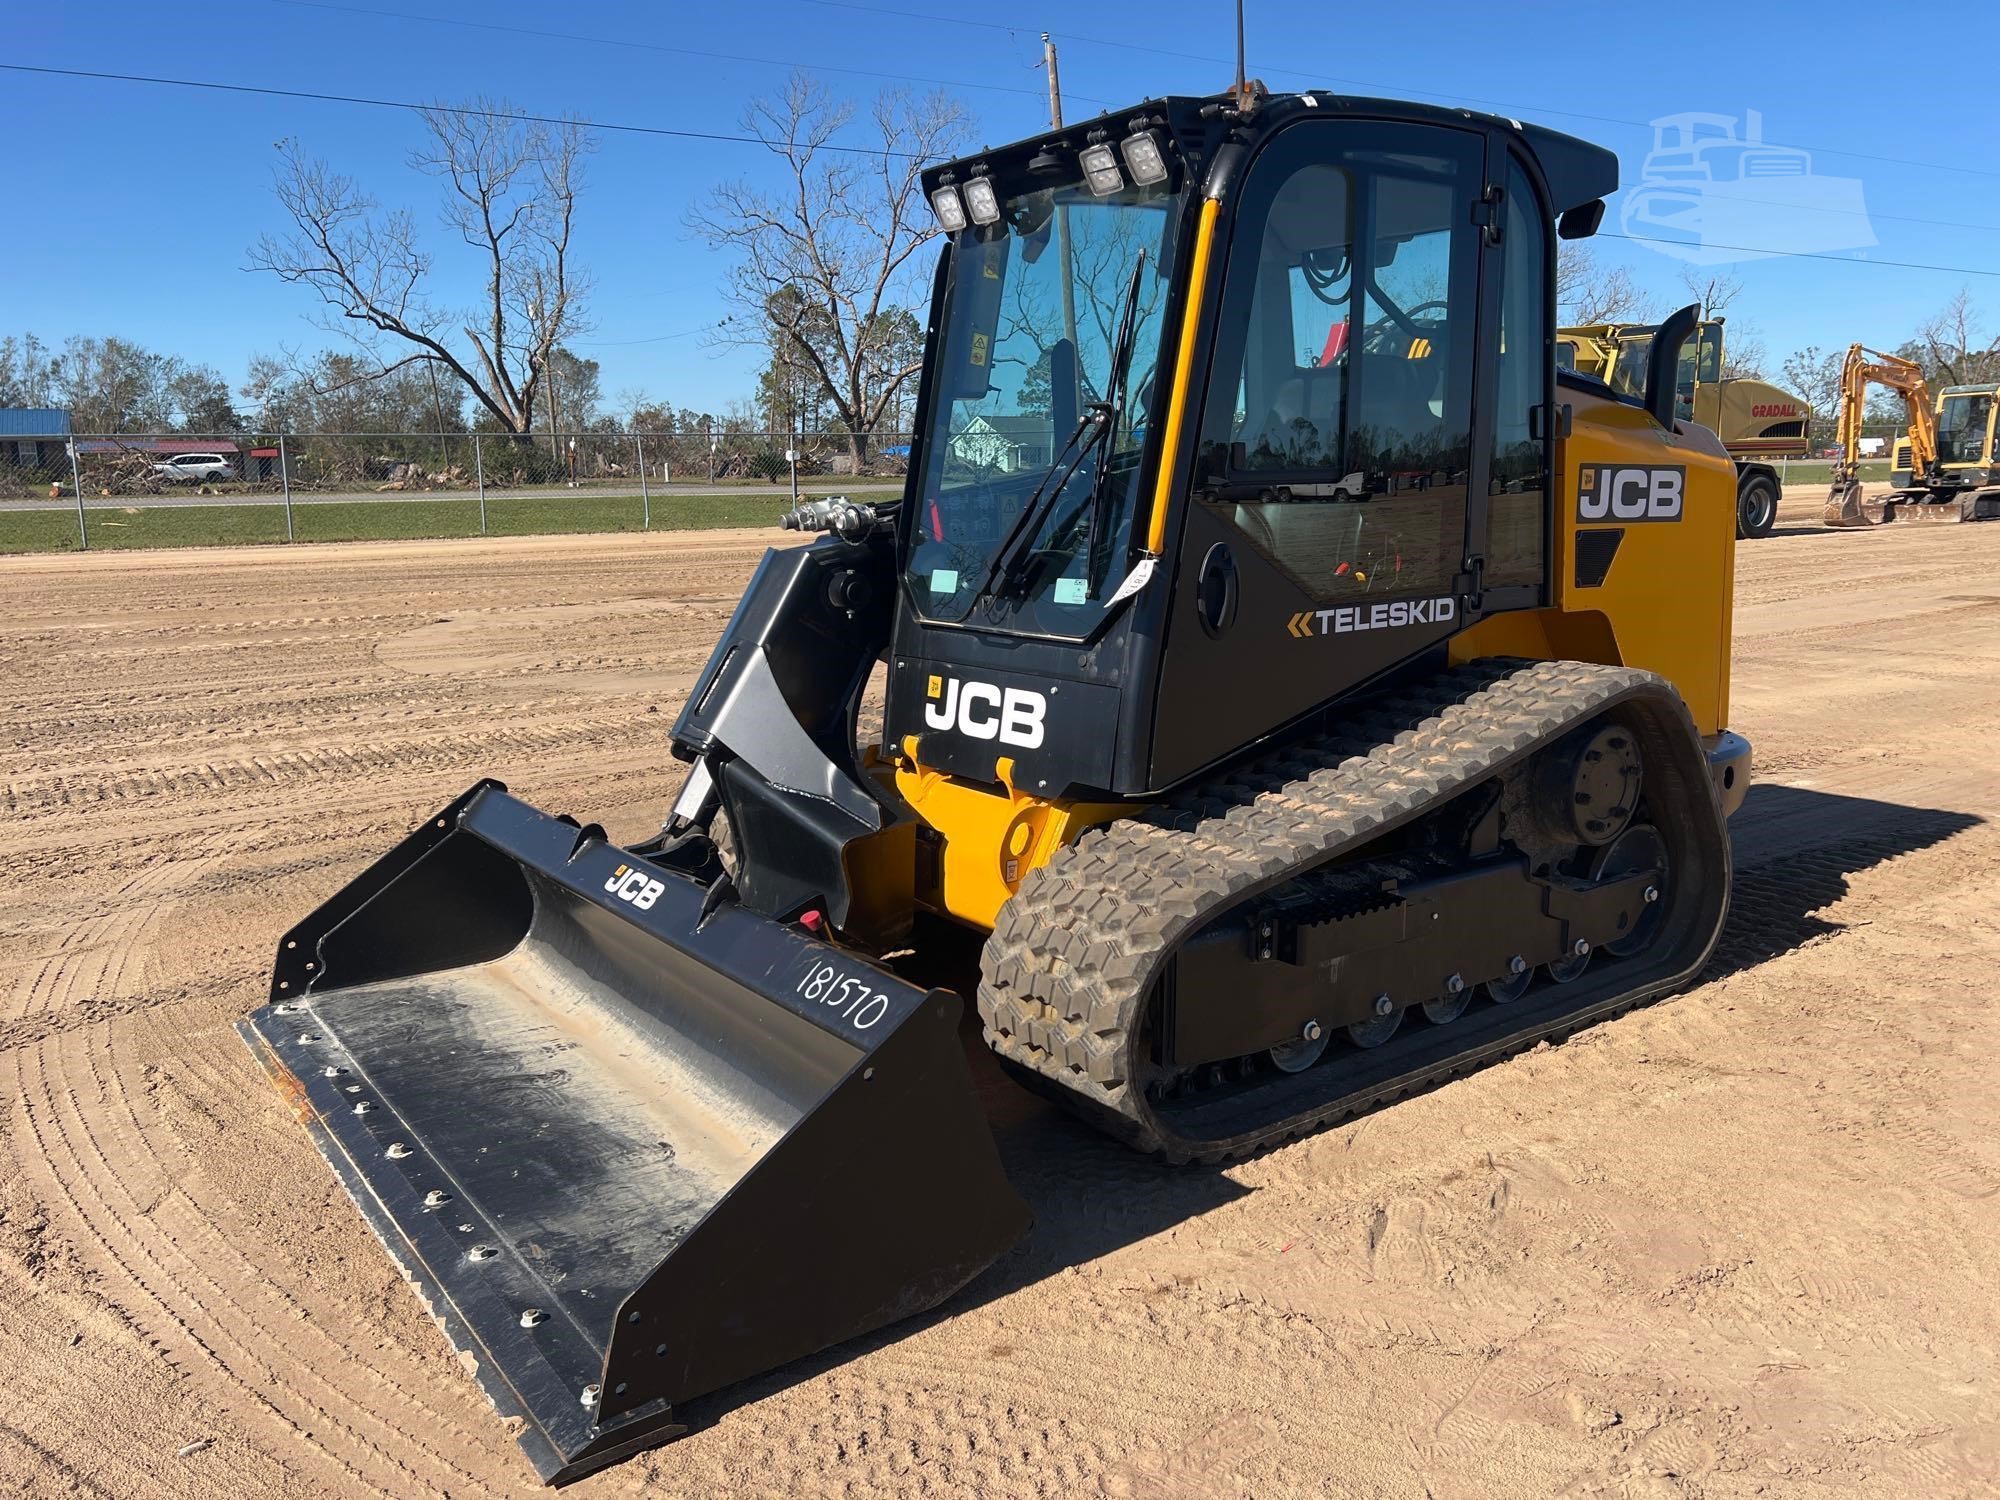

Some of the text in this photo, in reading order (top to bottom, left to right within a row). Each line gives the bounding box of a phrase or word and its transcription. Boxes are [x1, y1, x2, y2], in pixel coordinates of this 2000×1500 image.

[1752, 404, 1797, 418] GRADALL
[1580, 469, 1682, 518] JCB
[1315, 597, 1455, 635] TELESKID
[925, 677, 1047, 750] JCB
[604, 867, 665, 910] JCB
[796, 960, 889, 1029] 181570
